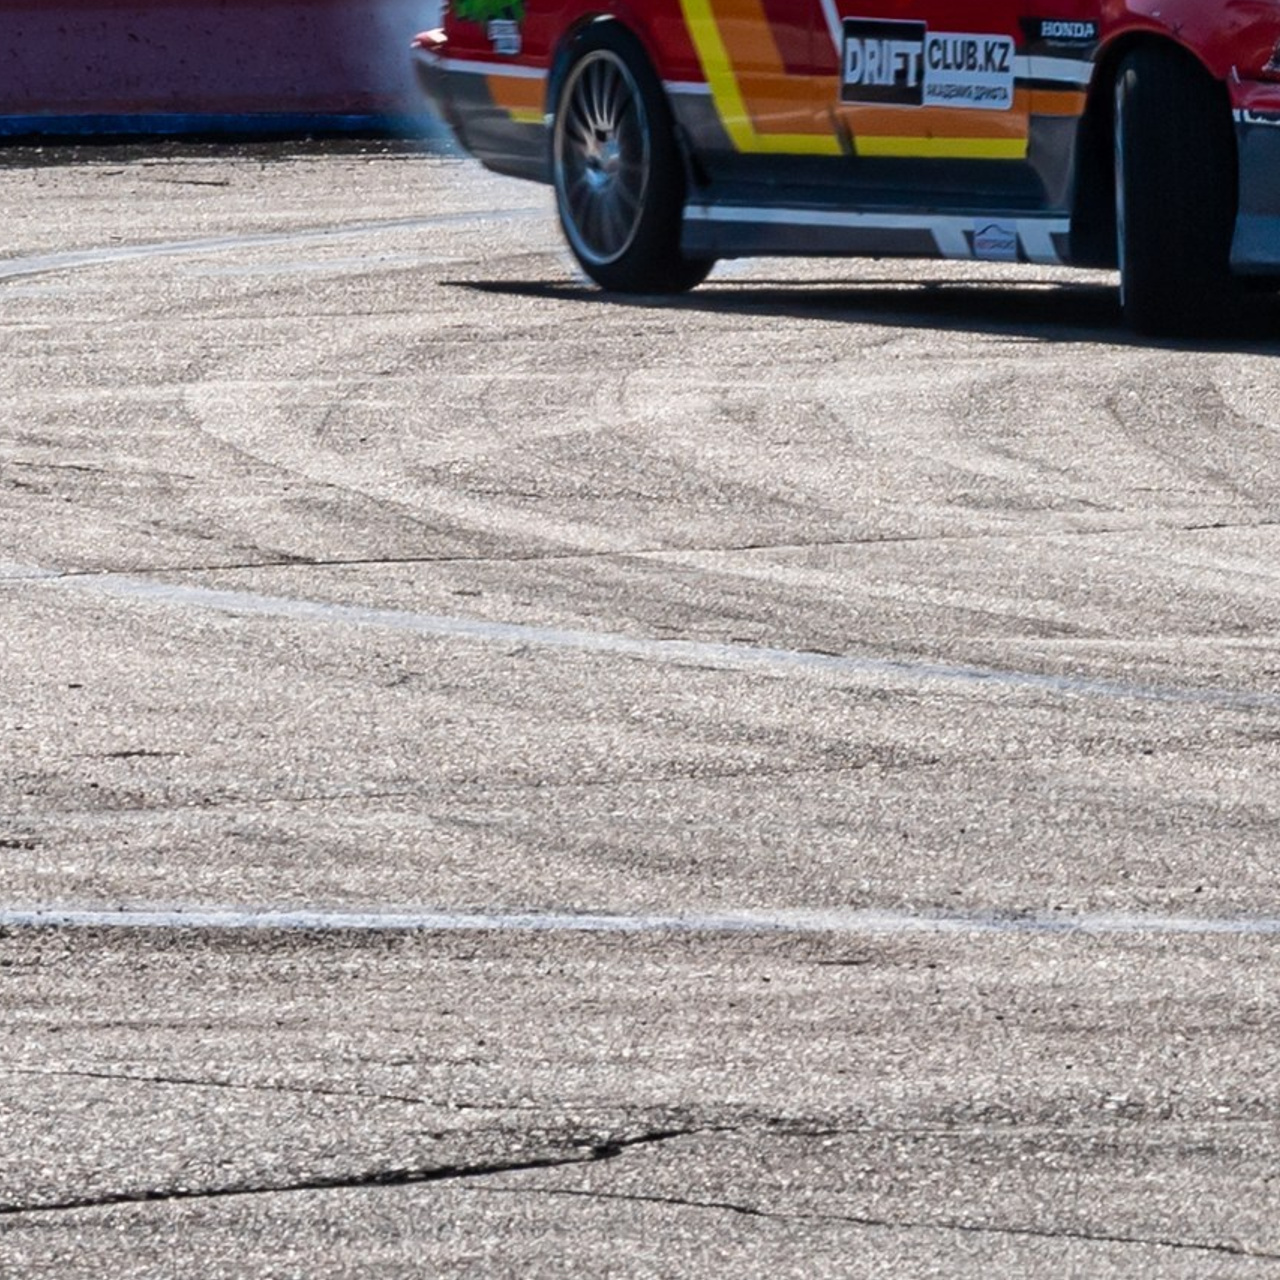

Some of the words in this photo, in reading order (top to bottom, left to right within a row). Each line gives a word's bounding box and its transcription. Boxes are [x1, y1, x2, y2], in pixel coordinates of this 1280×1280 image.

[1041, 21, 1094, 38] HONDA
[845, 38, 924, 88] DRIFT
[927, 38, 1010, 72] CLUB.KZ
